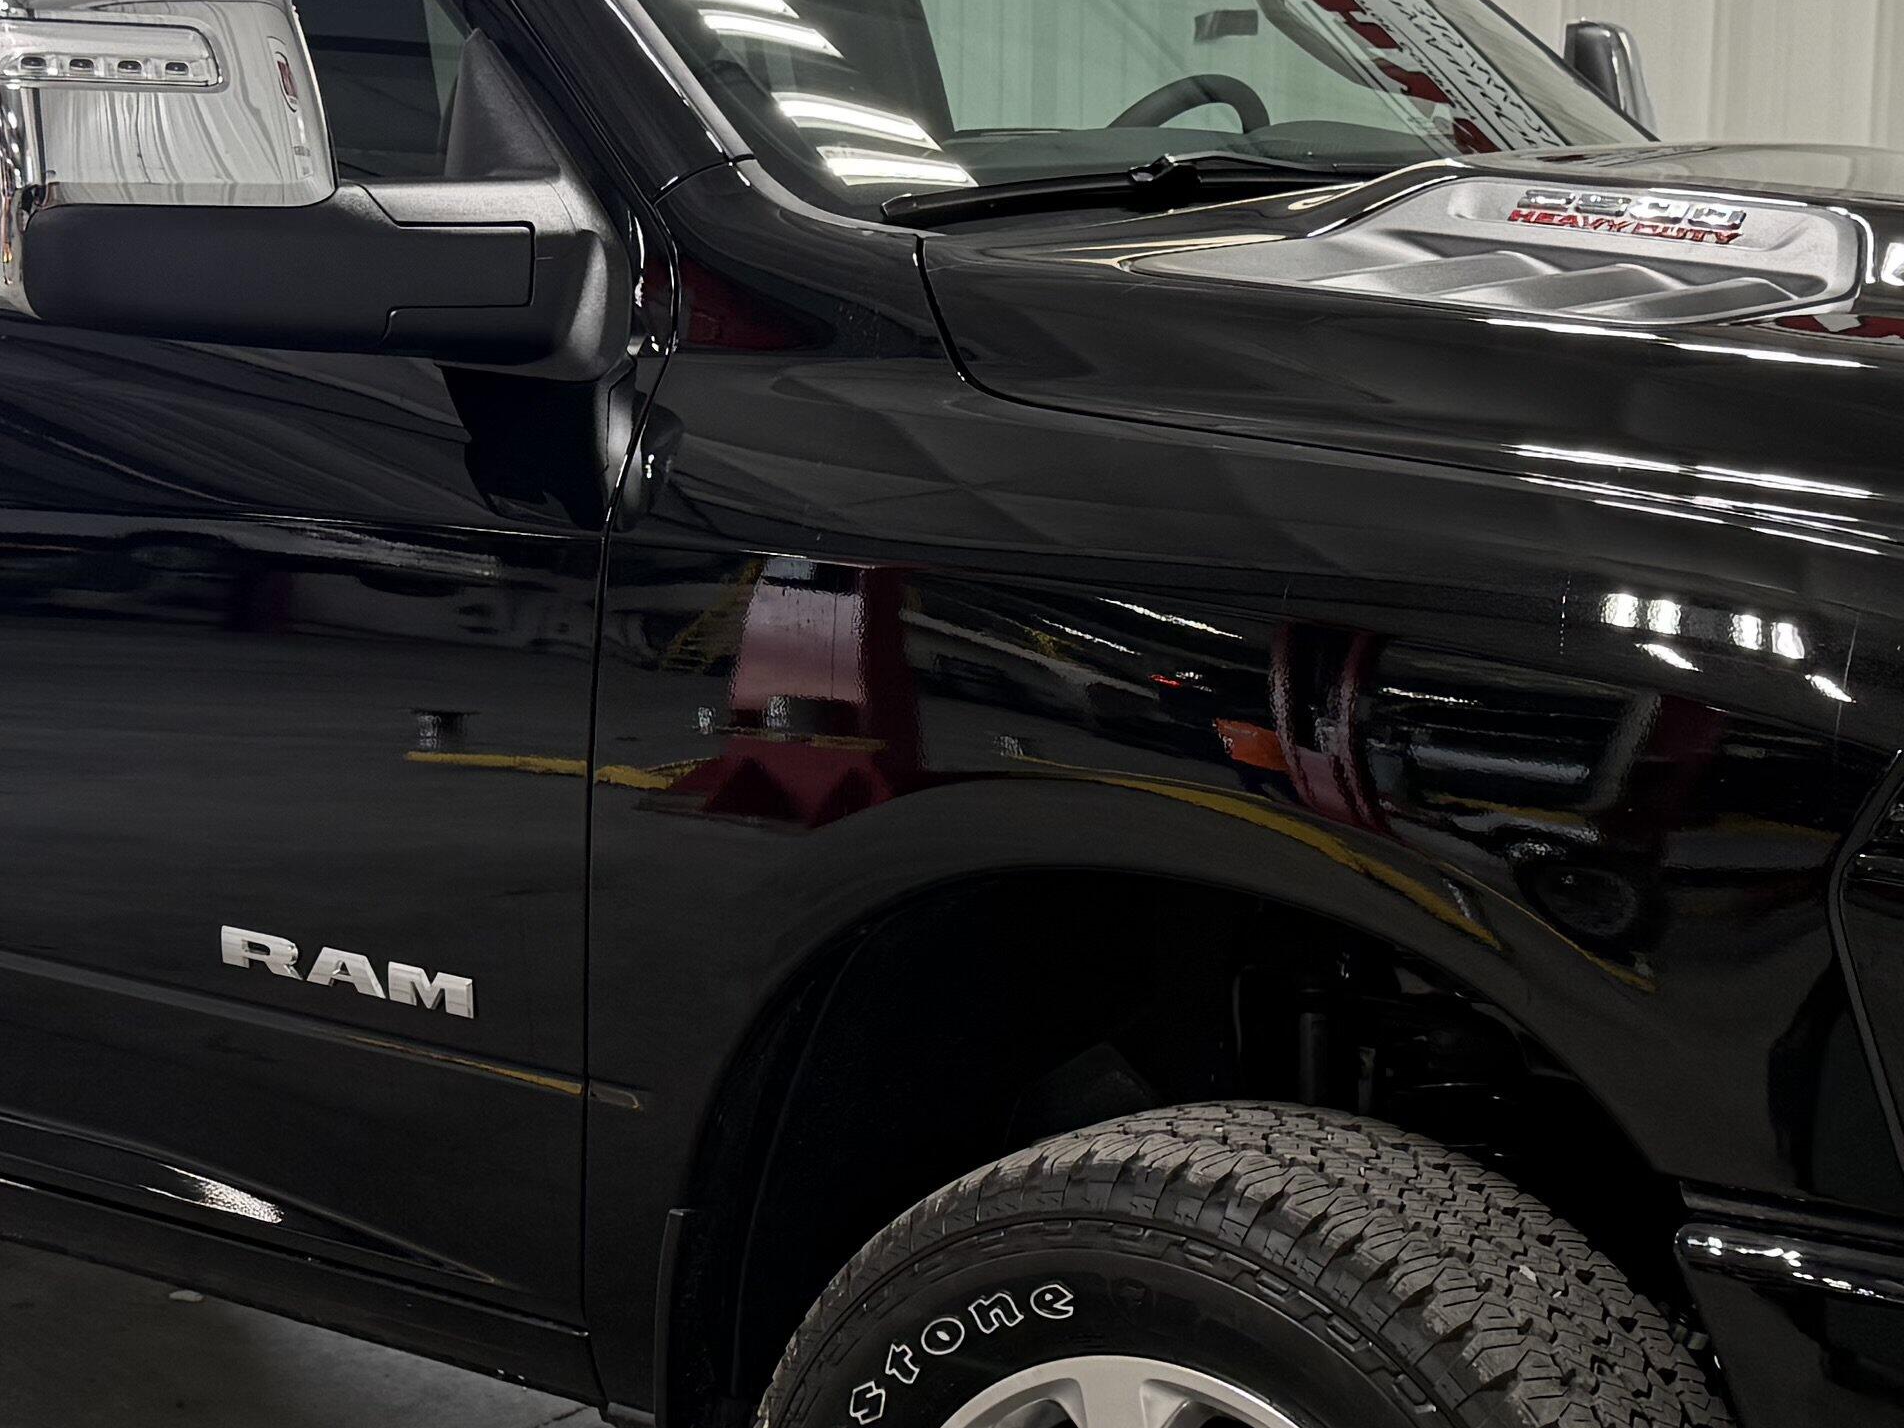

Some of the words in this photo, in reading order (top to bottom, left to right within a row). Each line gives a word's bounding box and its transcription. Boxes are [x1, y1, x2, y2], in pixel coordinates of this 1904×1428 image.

[1507, 209, 1632, 234] HEAVY
[1631, 222, 1744, 246] DUTY
[220, 924, 475, 1019] RAM
